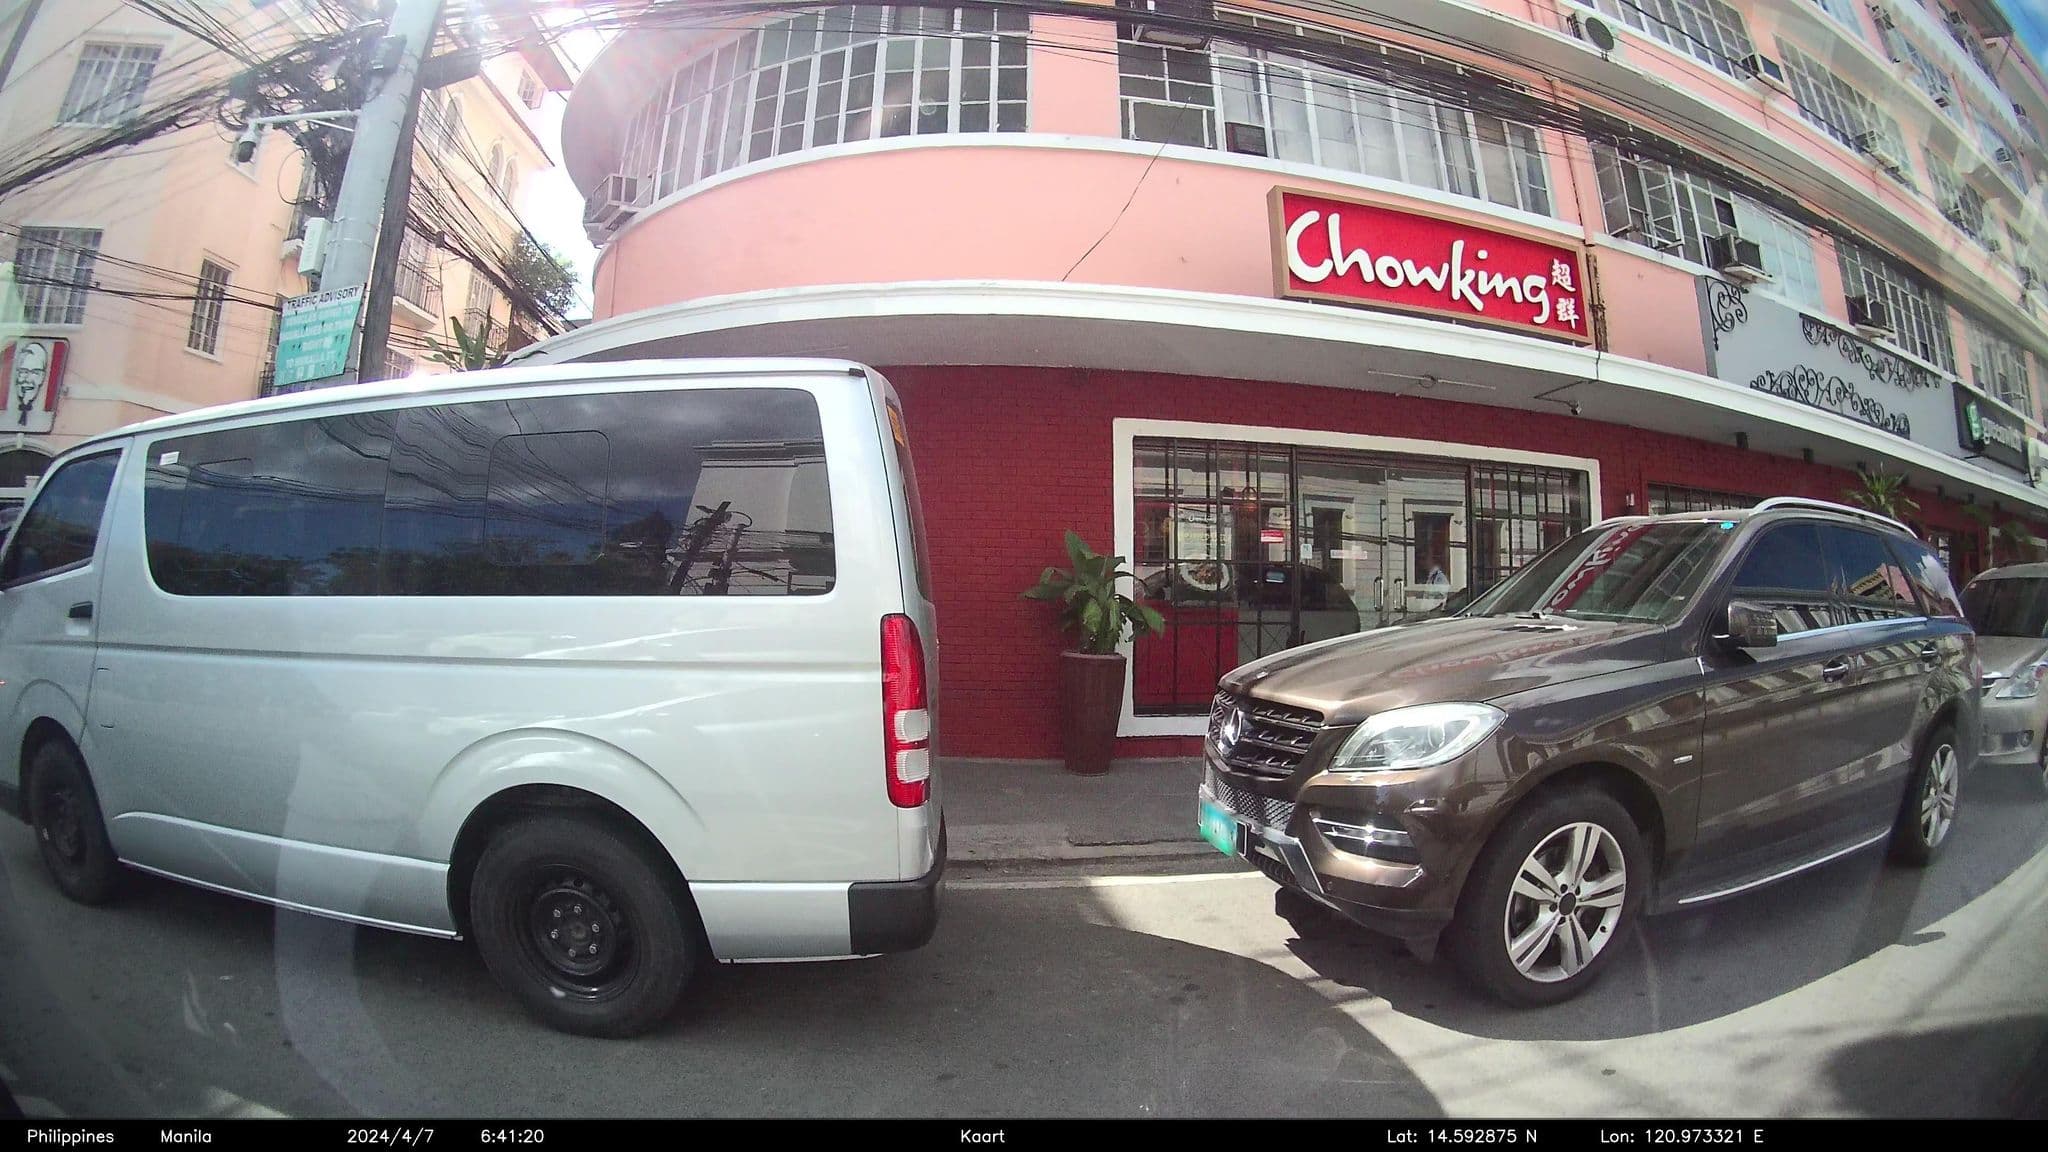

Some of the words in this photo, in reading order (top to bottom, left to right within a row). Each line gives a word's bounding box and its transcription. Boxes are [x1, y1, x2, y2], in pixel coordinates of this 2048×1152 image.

[287, 294, 318, 310] TRAFFIC
[319, 286, 360, 303] ADVISORY
[1286, 210, 1550, 325] Chowking
